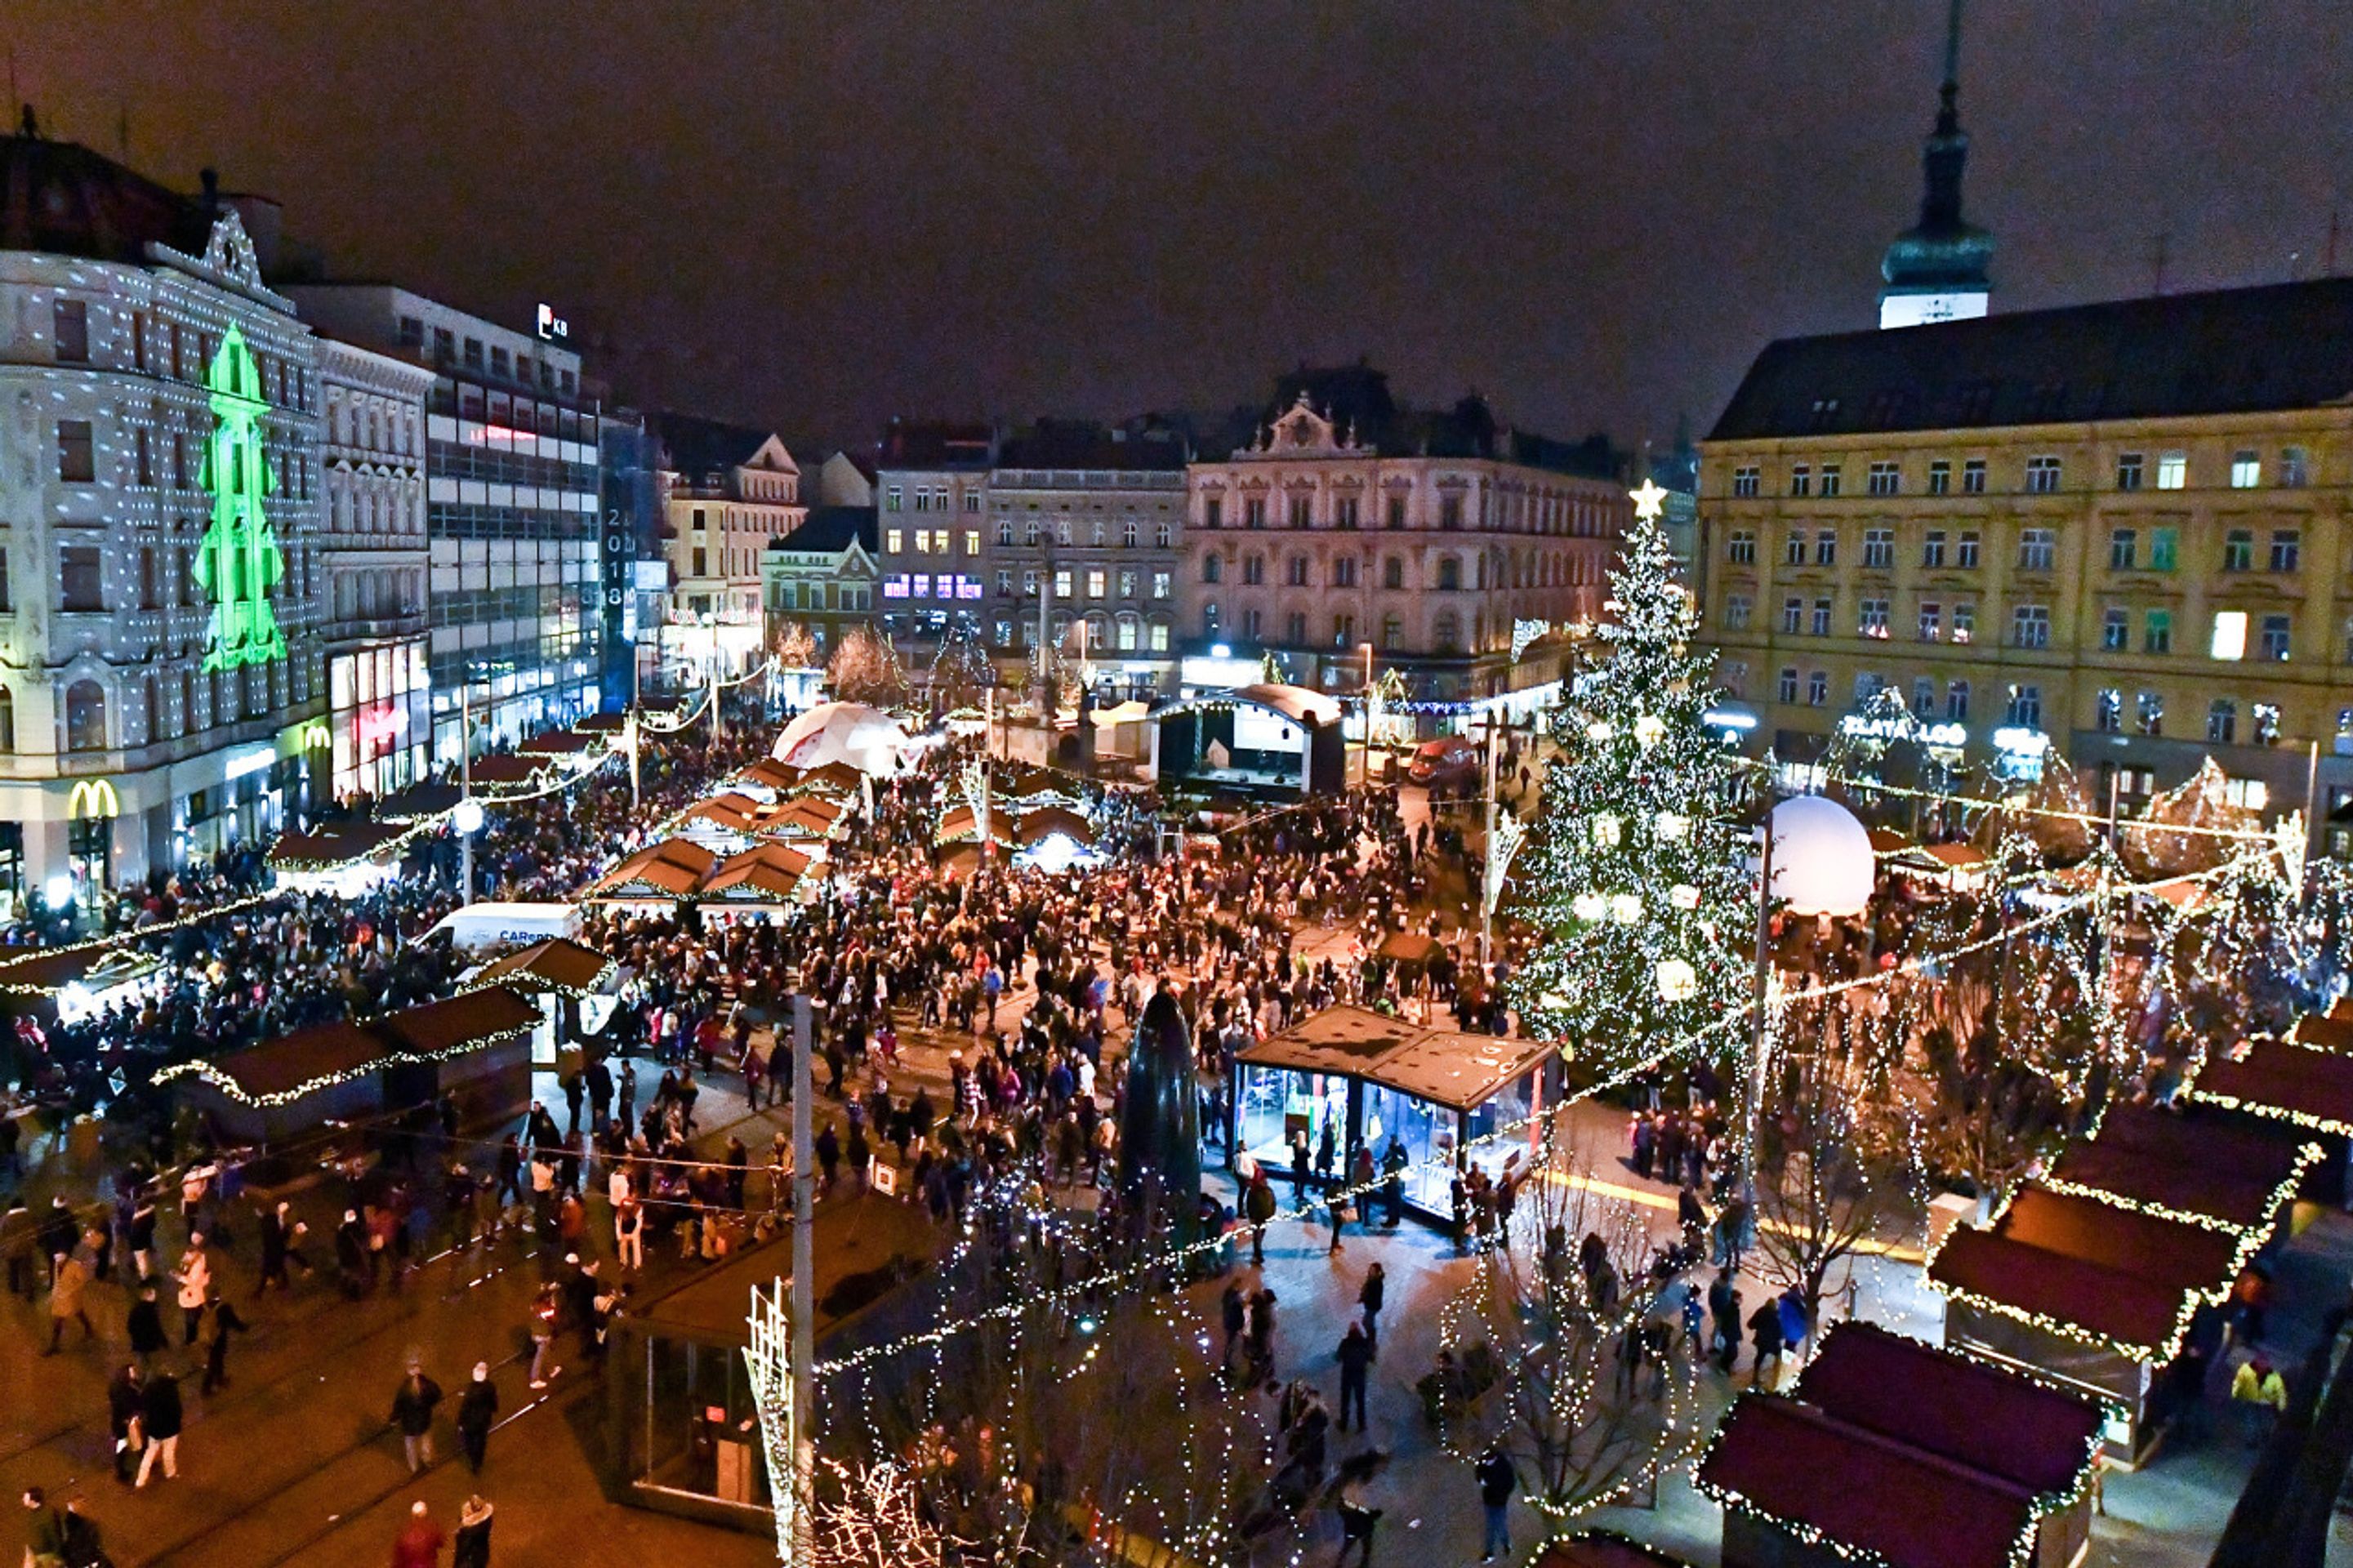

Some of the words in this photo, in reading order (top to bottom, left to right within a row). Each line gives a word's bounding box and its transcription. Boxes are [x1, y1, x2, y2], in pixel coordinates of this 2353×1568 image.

[552, 318, 568, 336] KB
[607, 508, 622, 605] 2018
[305, 725, 332, 748] M
[69, 779, 118, 819] M
